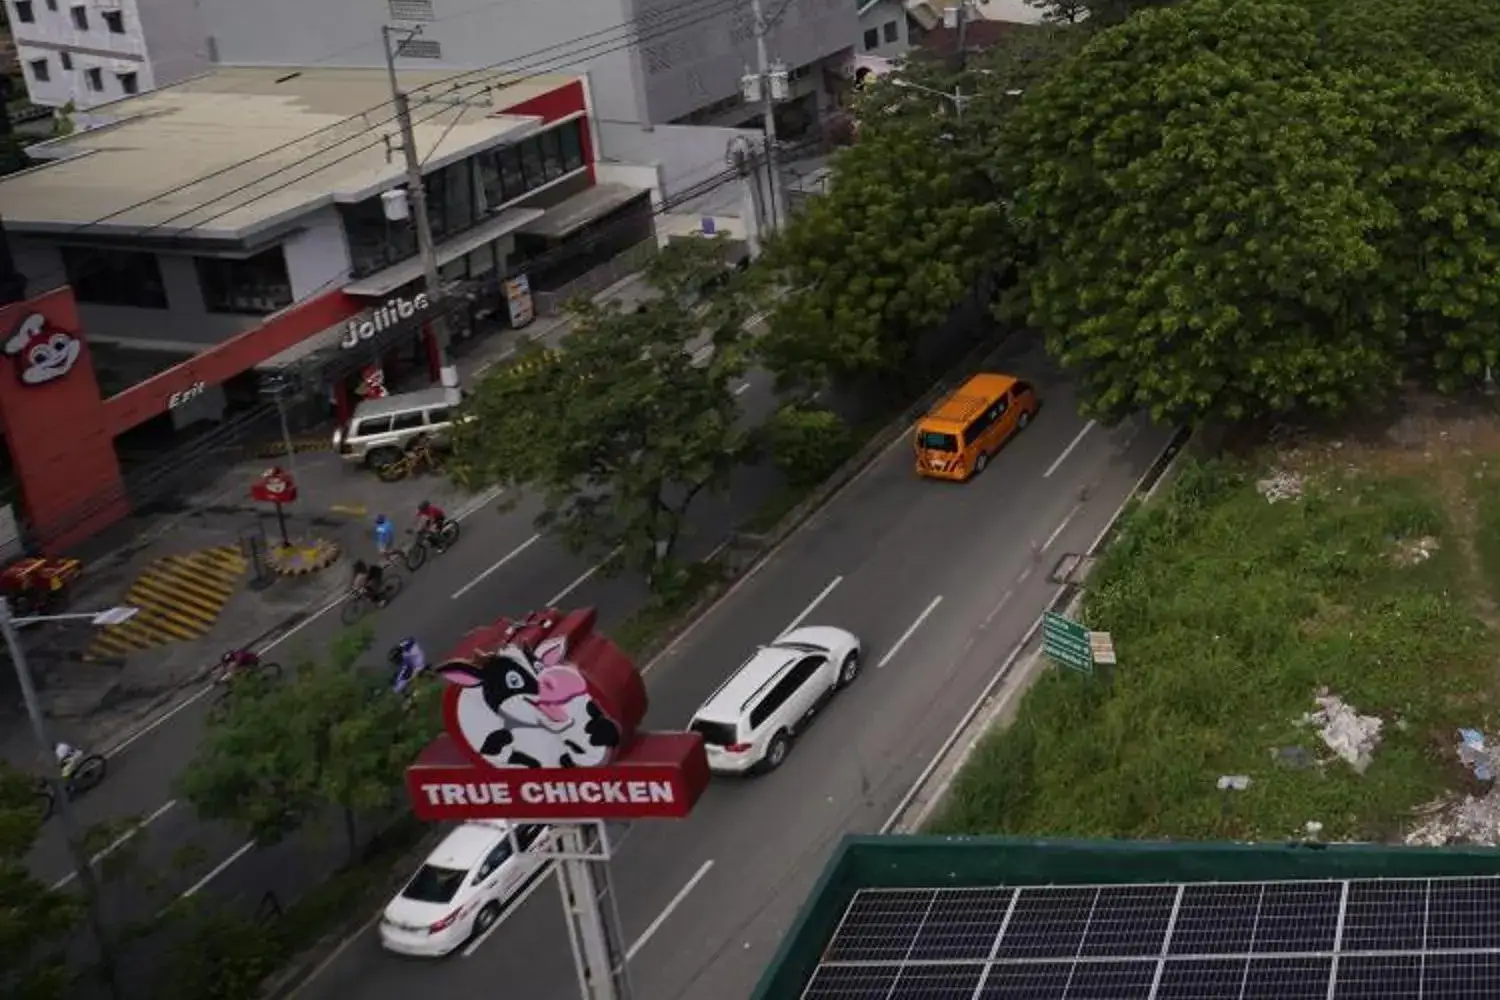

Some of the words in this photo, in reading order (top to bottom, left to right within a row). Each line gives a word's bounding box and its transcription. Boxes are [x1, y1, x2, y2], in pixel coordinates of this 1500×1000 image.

[342, 293, 429, 348] Jollibe
[421, 783, 512, 805] TRUE
[520, 781, 674, 803] CHICKEN
